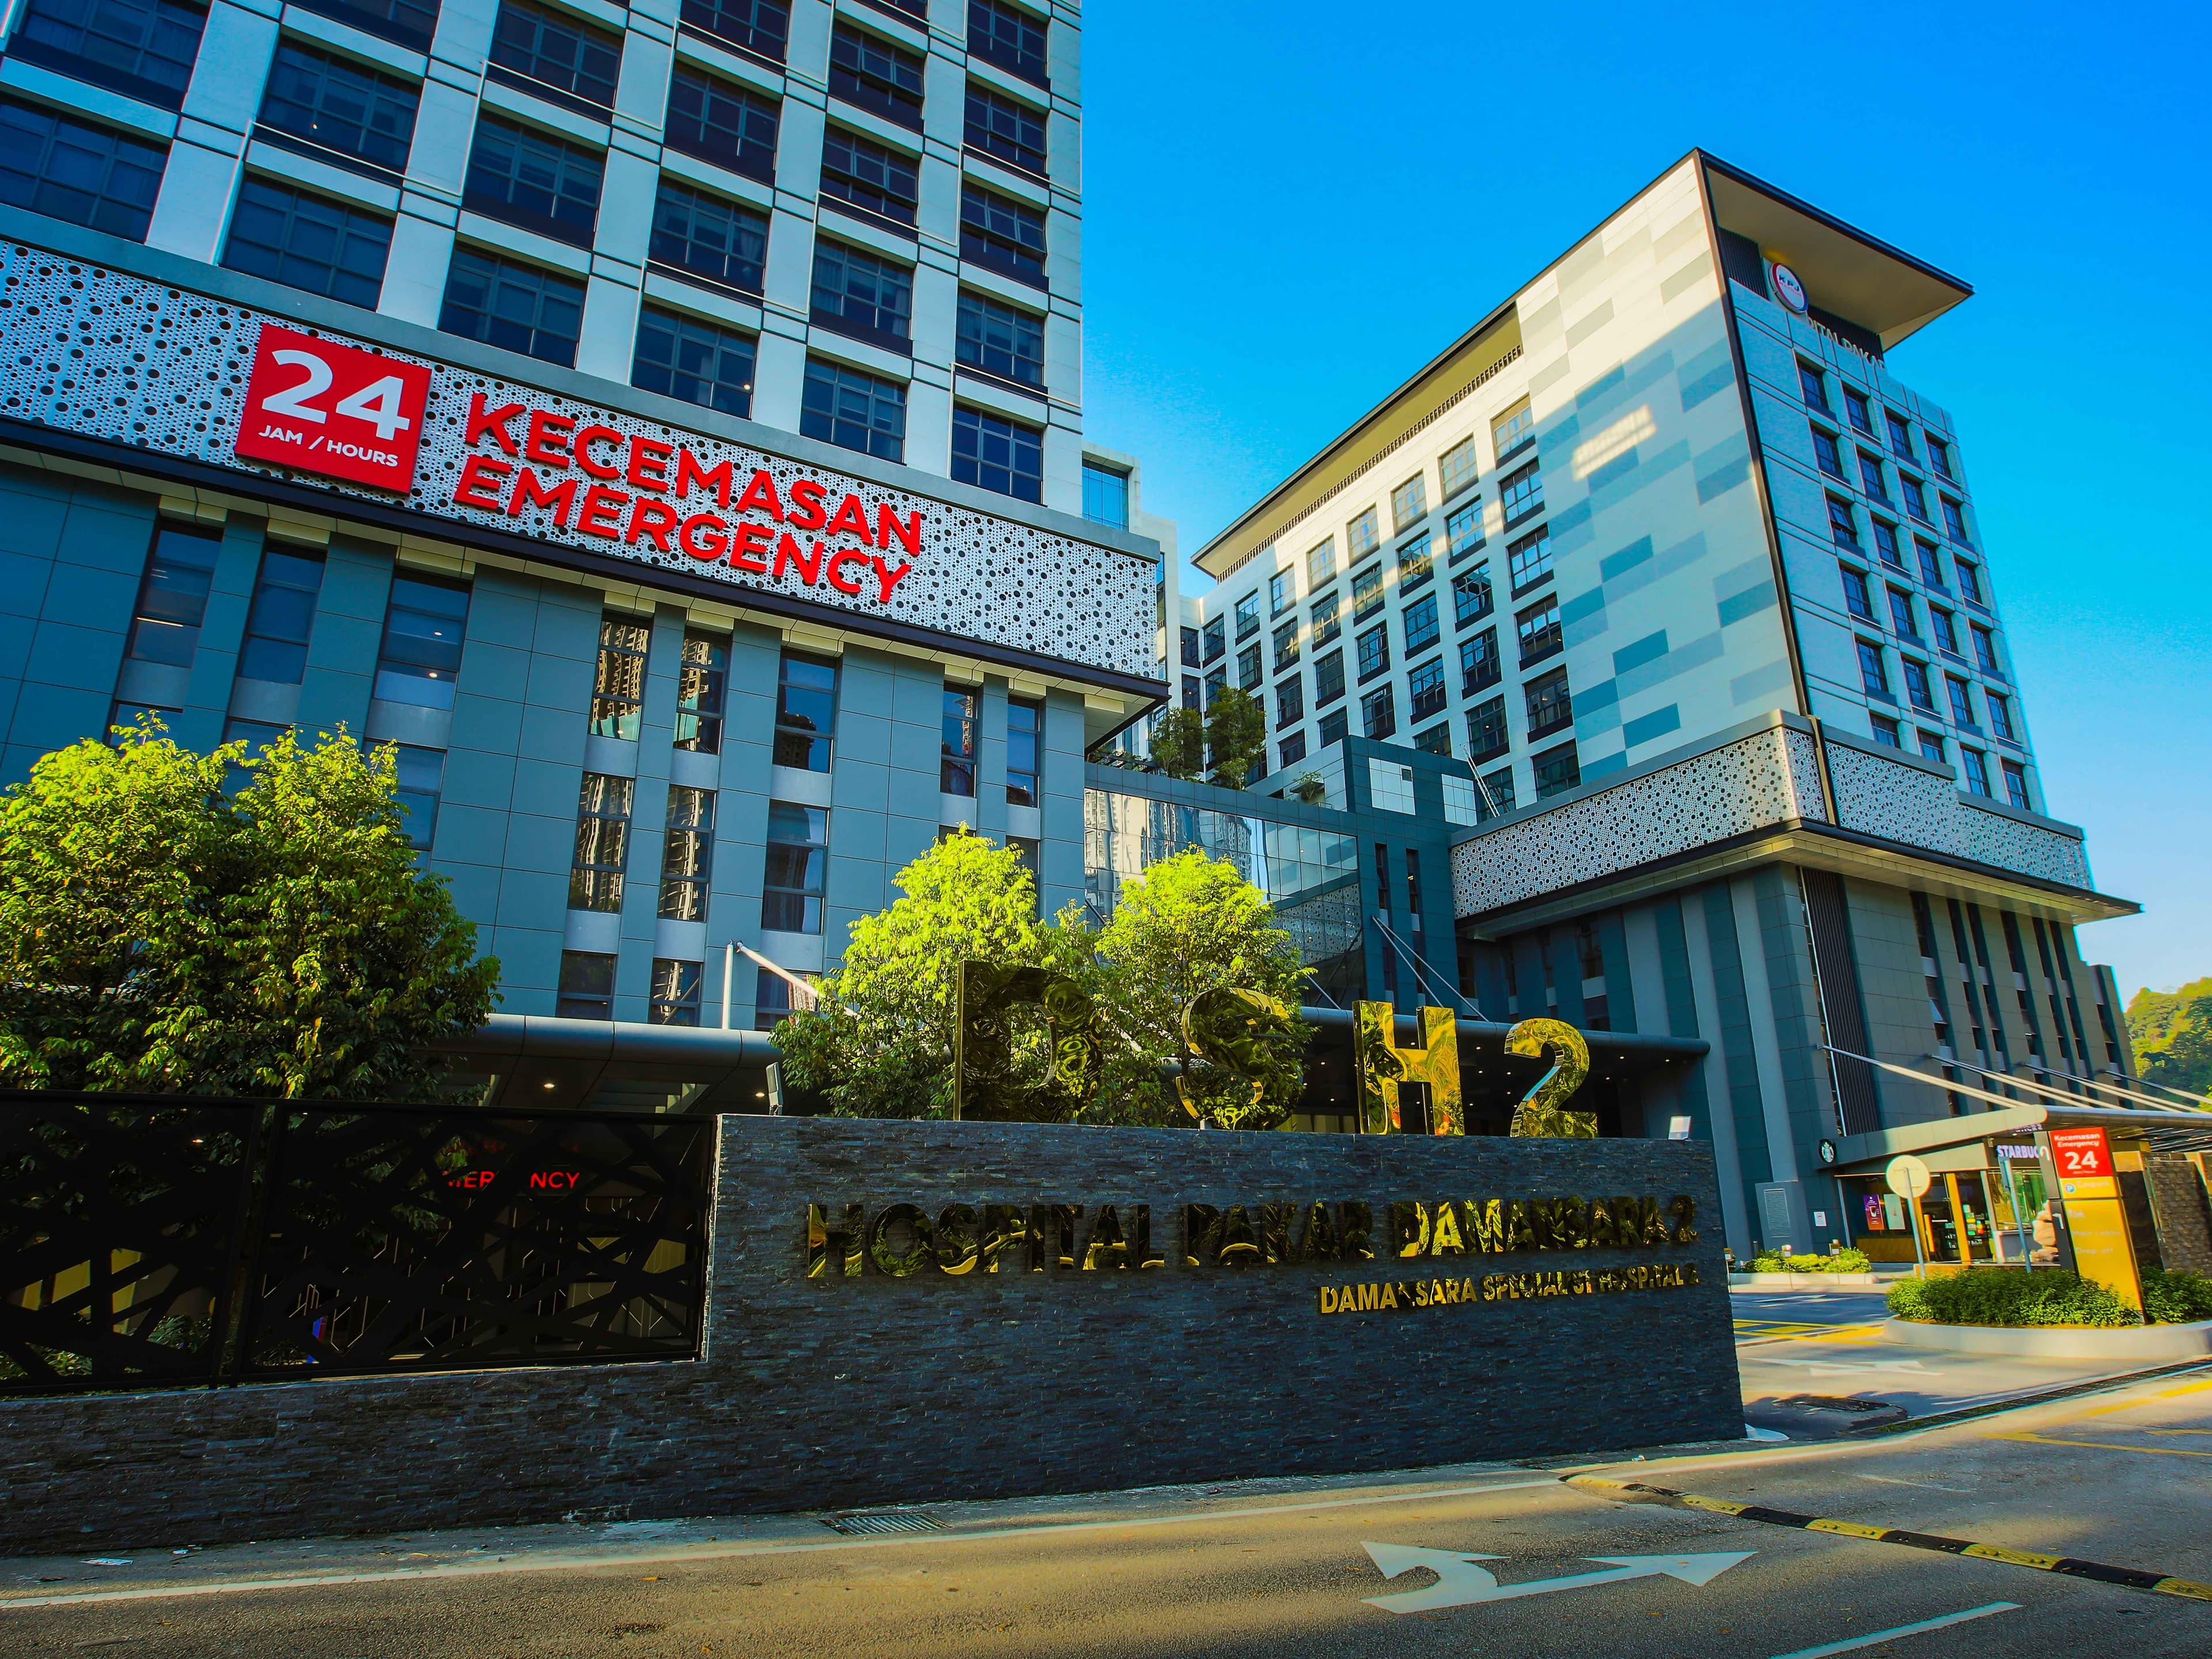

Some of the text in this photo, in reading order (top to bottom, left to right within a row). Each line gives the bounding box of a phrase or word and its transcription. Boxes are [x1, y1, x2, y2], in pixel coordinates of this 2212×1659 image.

[1779, 274, 1800, 291] KPJ
[261, 349, 410, 441] 24
[258, 425, 399, 467] JAM / HOURS
[464, 393, 923, 557] KECEMASAN
[453, 453, 912, 604] EMERGENCY
[1996, 1145, 2039, 1158] STARBUC
[2054, 1133, 2100, 1141] Kecemasan
[2065, 1151, 2098, 1170] 24
[807, 1195, 1699, 1278] HOSPITAL PAKAR DAMANSARA 2
[1482, 1270, 1593, 1301] SPECIALIST
[1599, 1263, 1684, 1293] HOSPITAL
